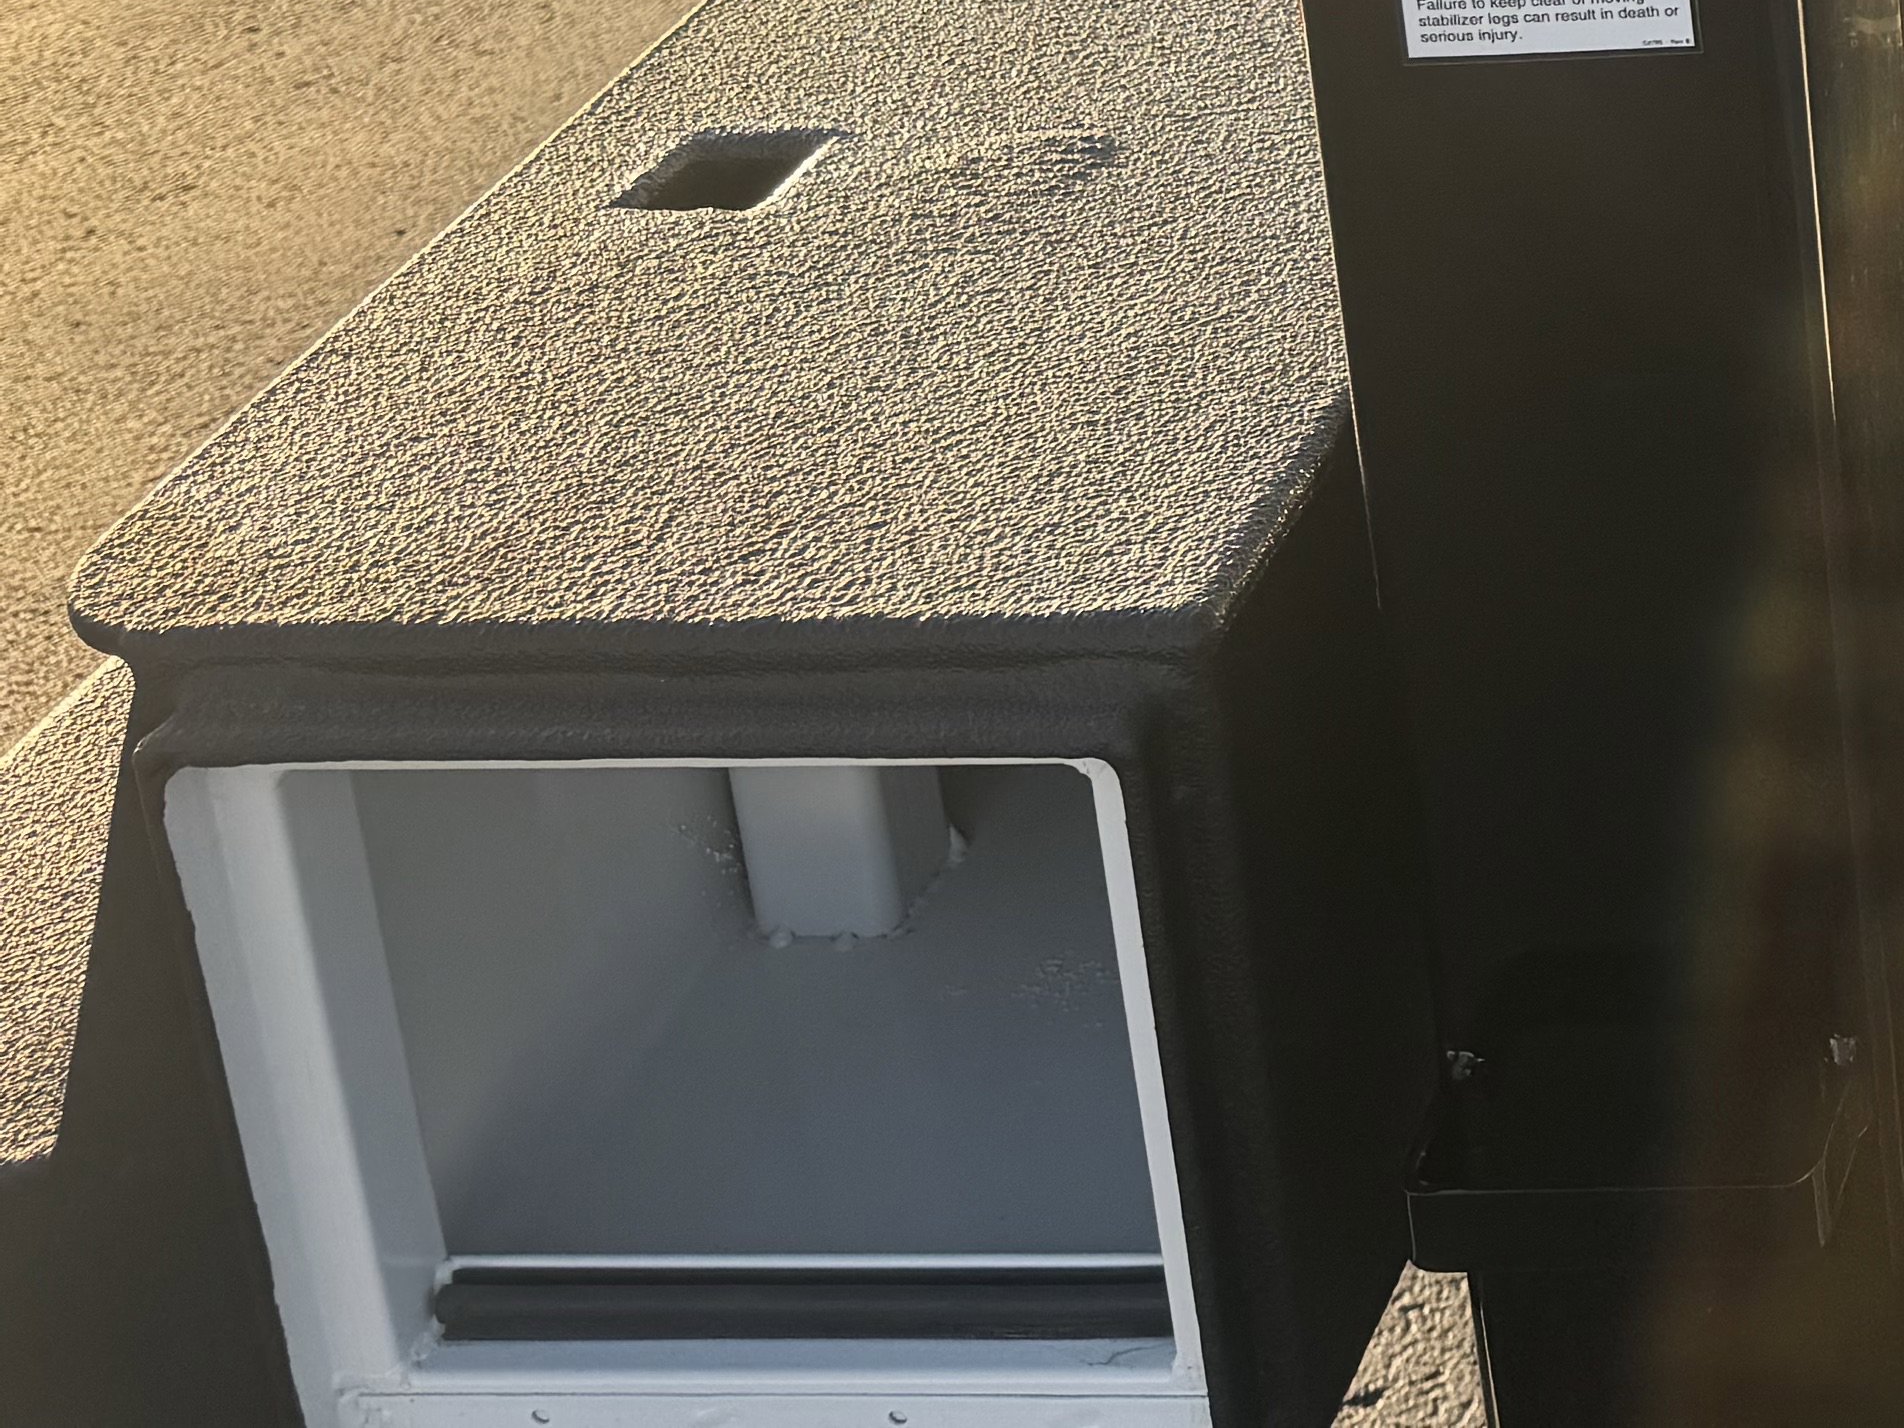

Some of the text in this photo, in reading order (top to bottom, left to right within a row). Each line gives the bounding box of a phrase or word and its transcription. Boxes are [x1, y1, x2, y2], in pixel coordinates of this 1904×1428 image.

[1418, 5, 1678, 26] stabilizer legs can result in death or
[1420, 26, 1522, 43] serious injury.
